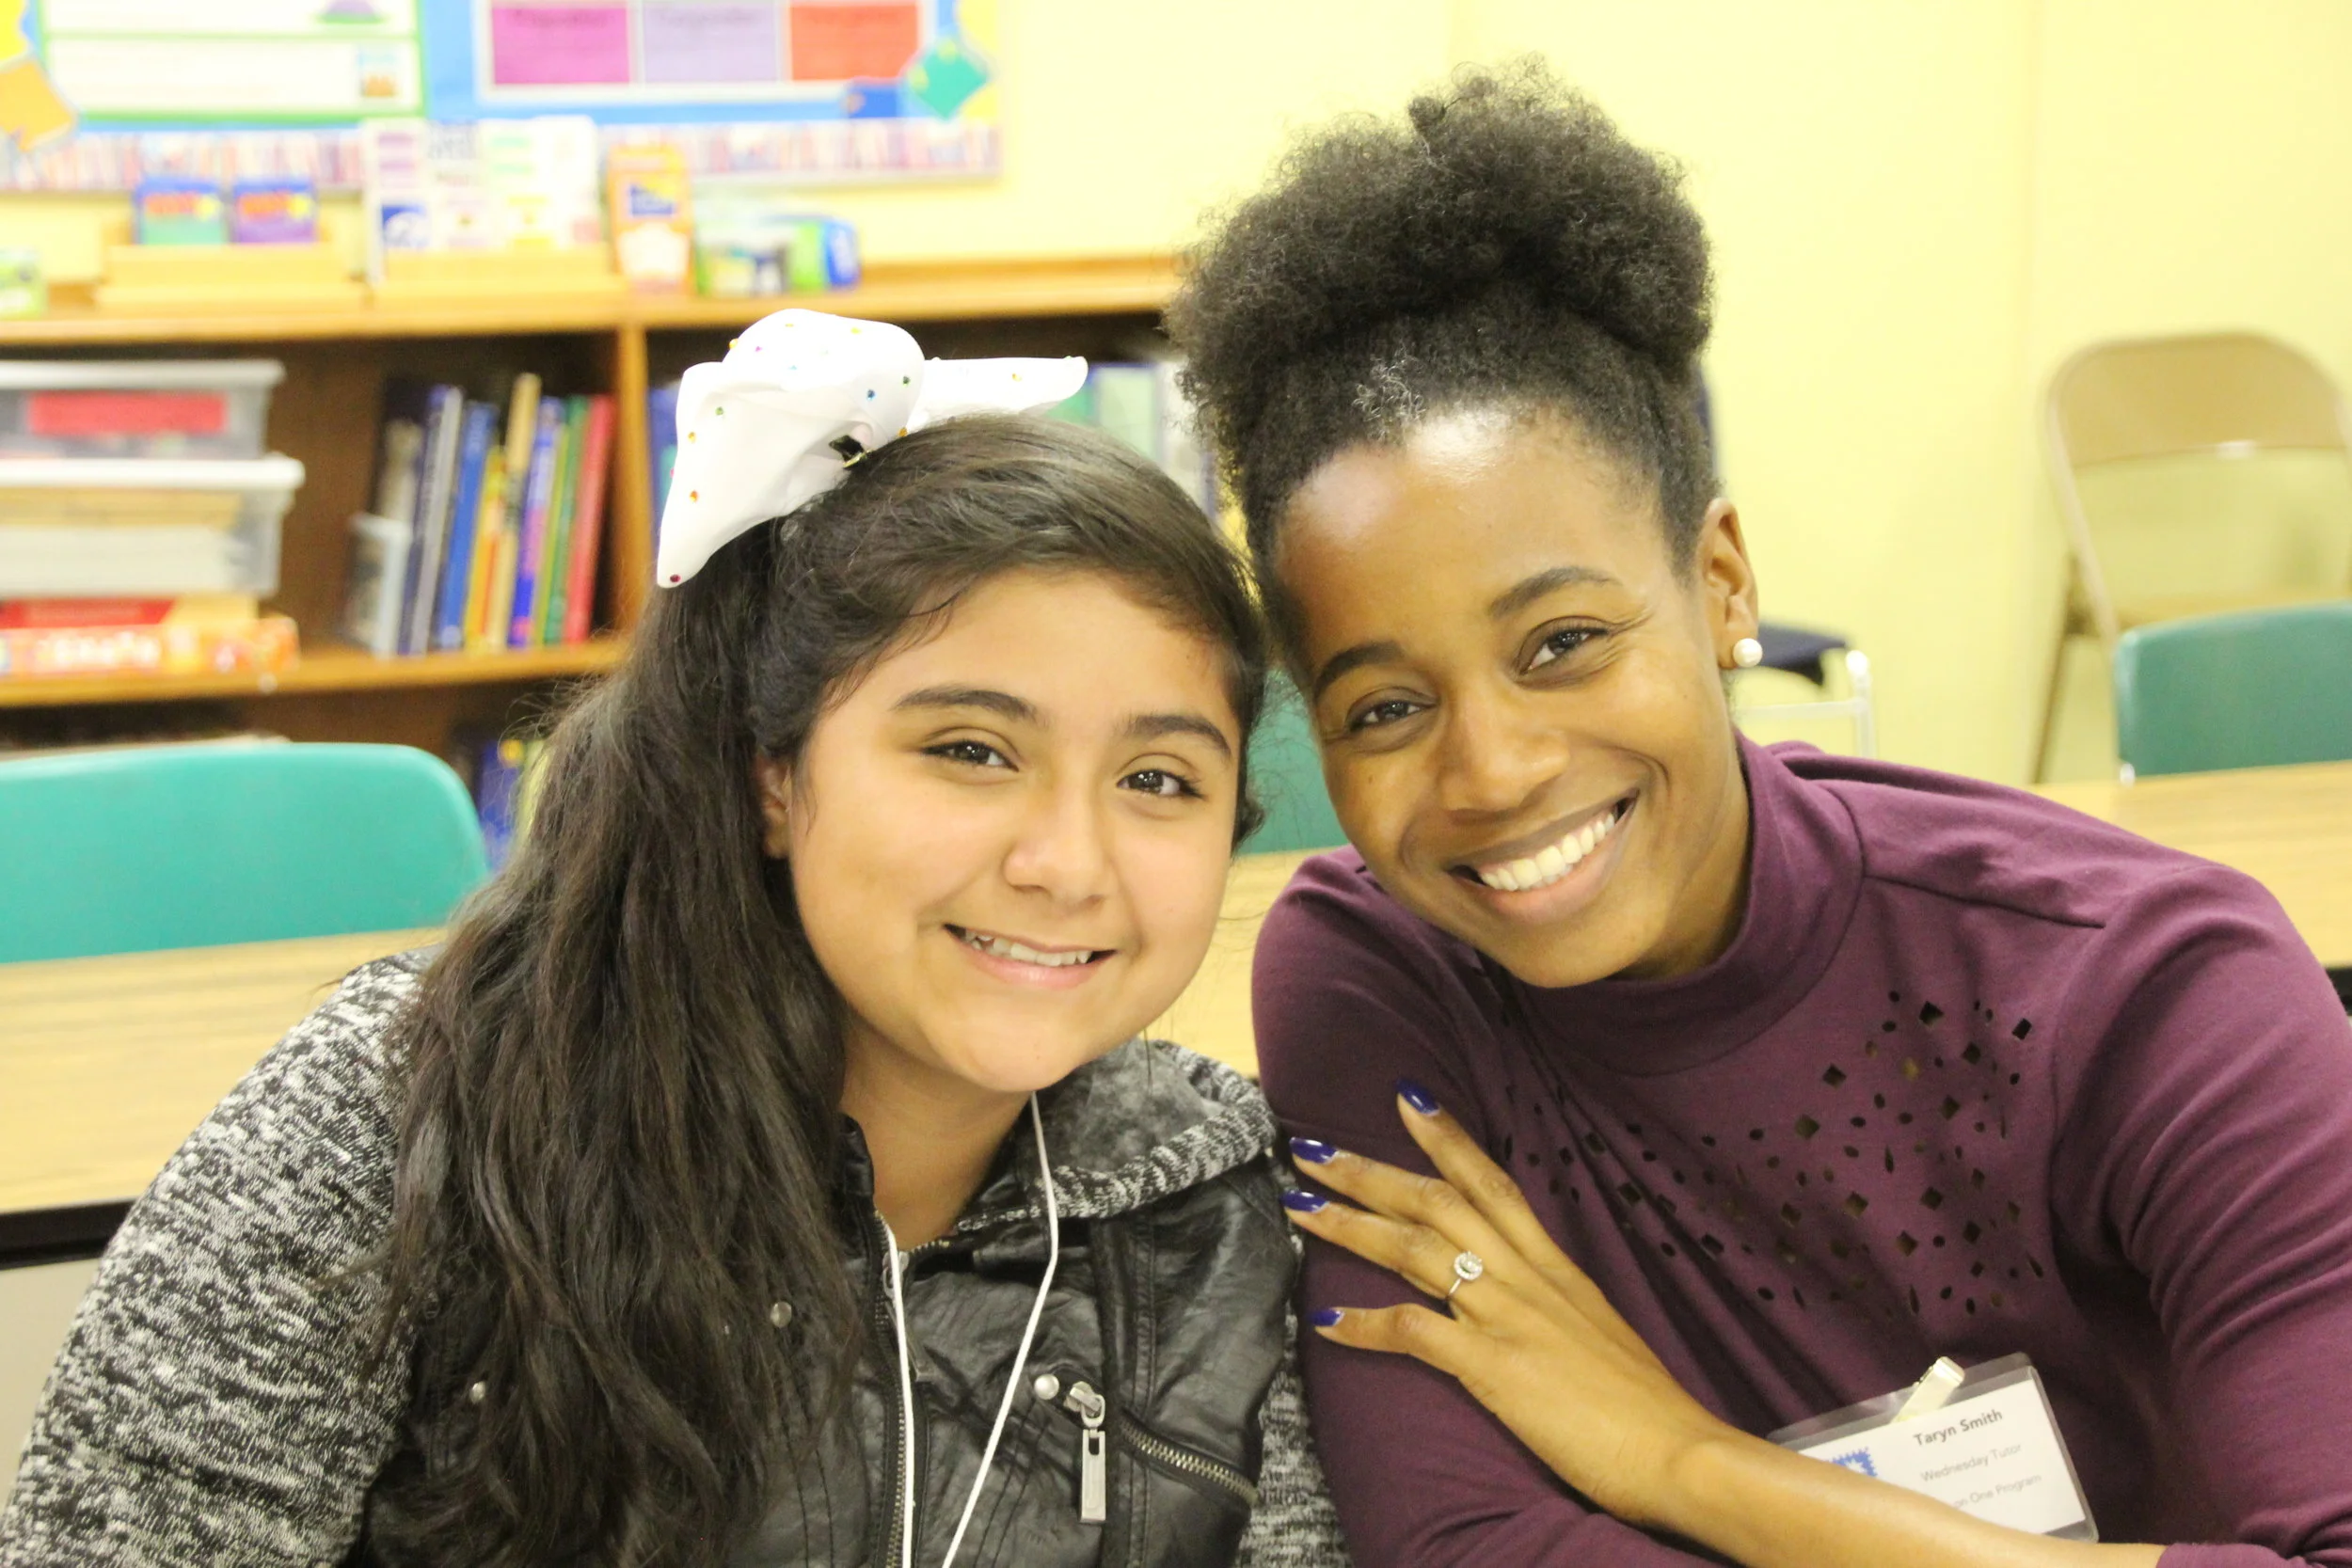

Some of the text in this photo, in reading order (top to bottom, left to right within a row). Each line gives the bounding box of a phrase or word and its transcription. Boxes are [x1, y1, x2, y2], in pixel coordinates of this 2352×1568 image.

[1913, 1409, 2003, 1447] Taryn Smith
[1920, 1444, 2022, 1482] Wednesday Tutor
[1969, 1490, 1994, 1503] One
[1994, 1474, 2042, 1494] Program
